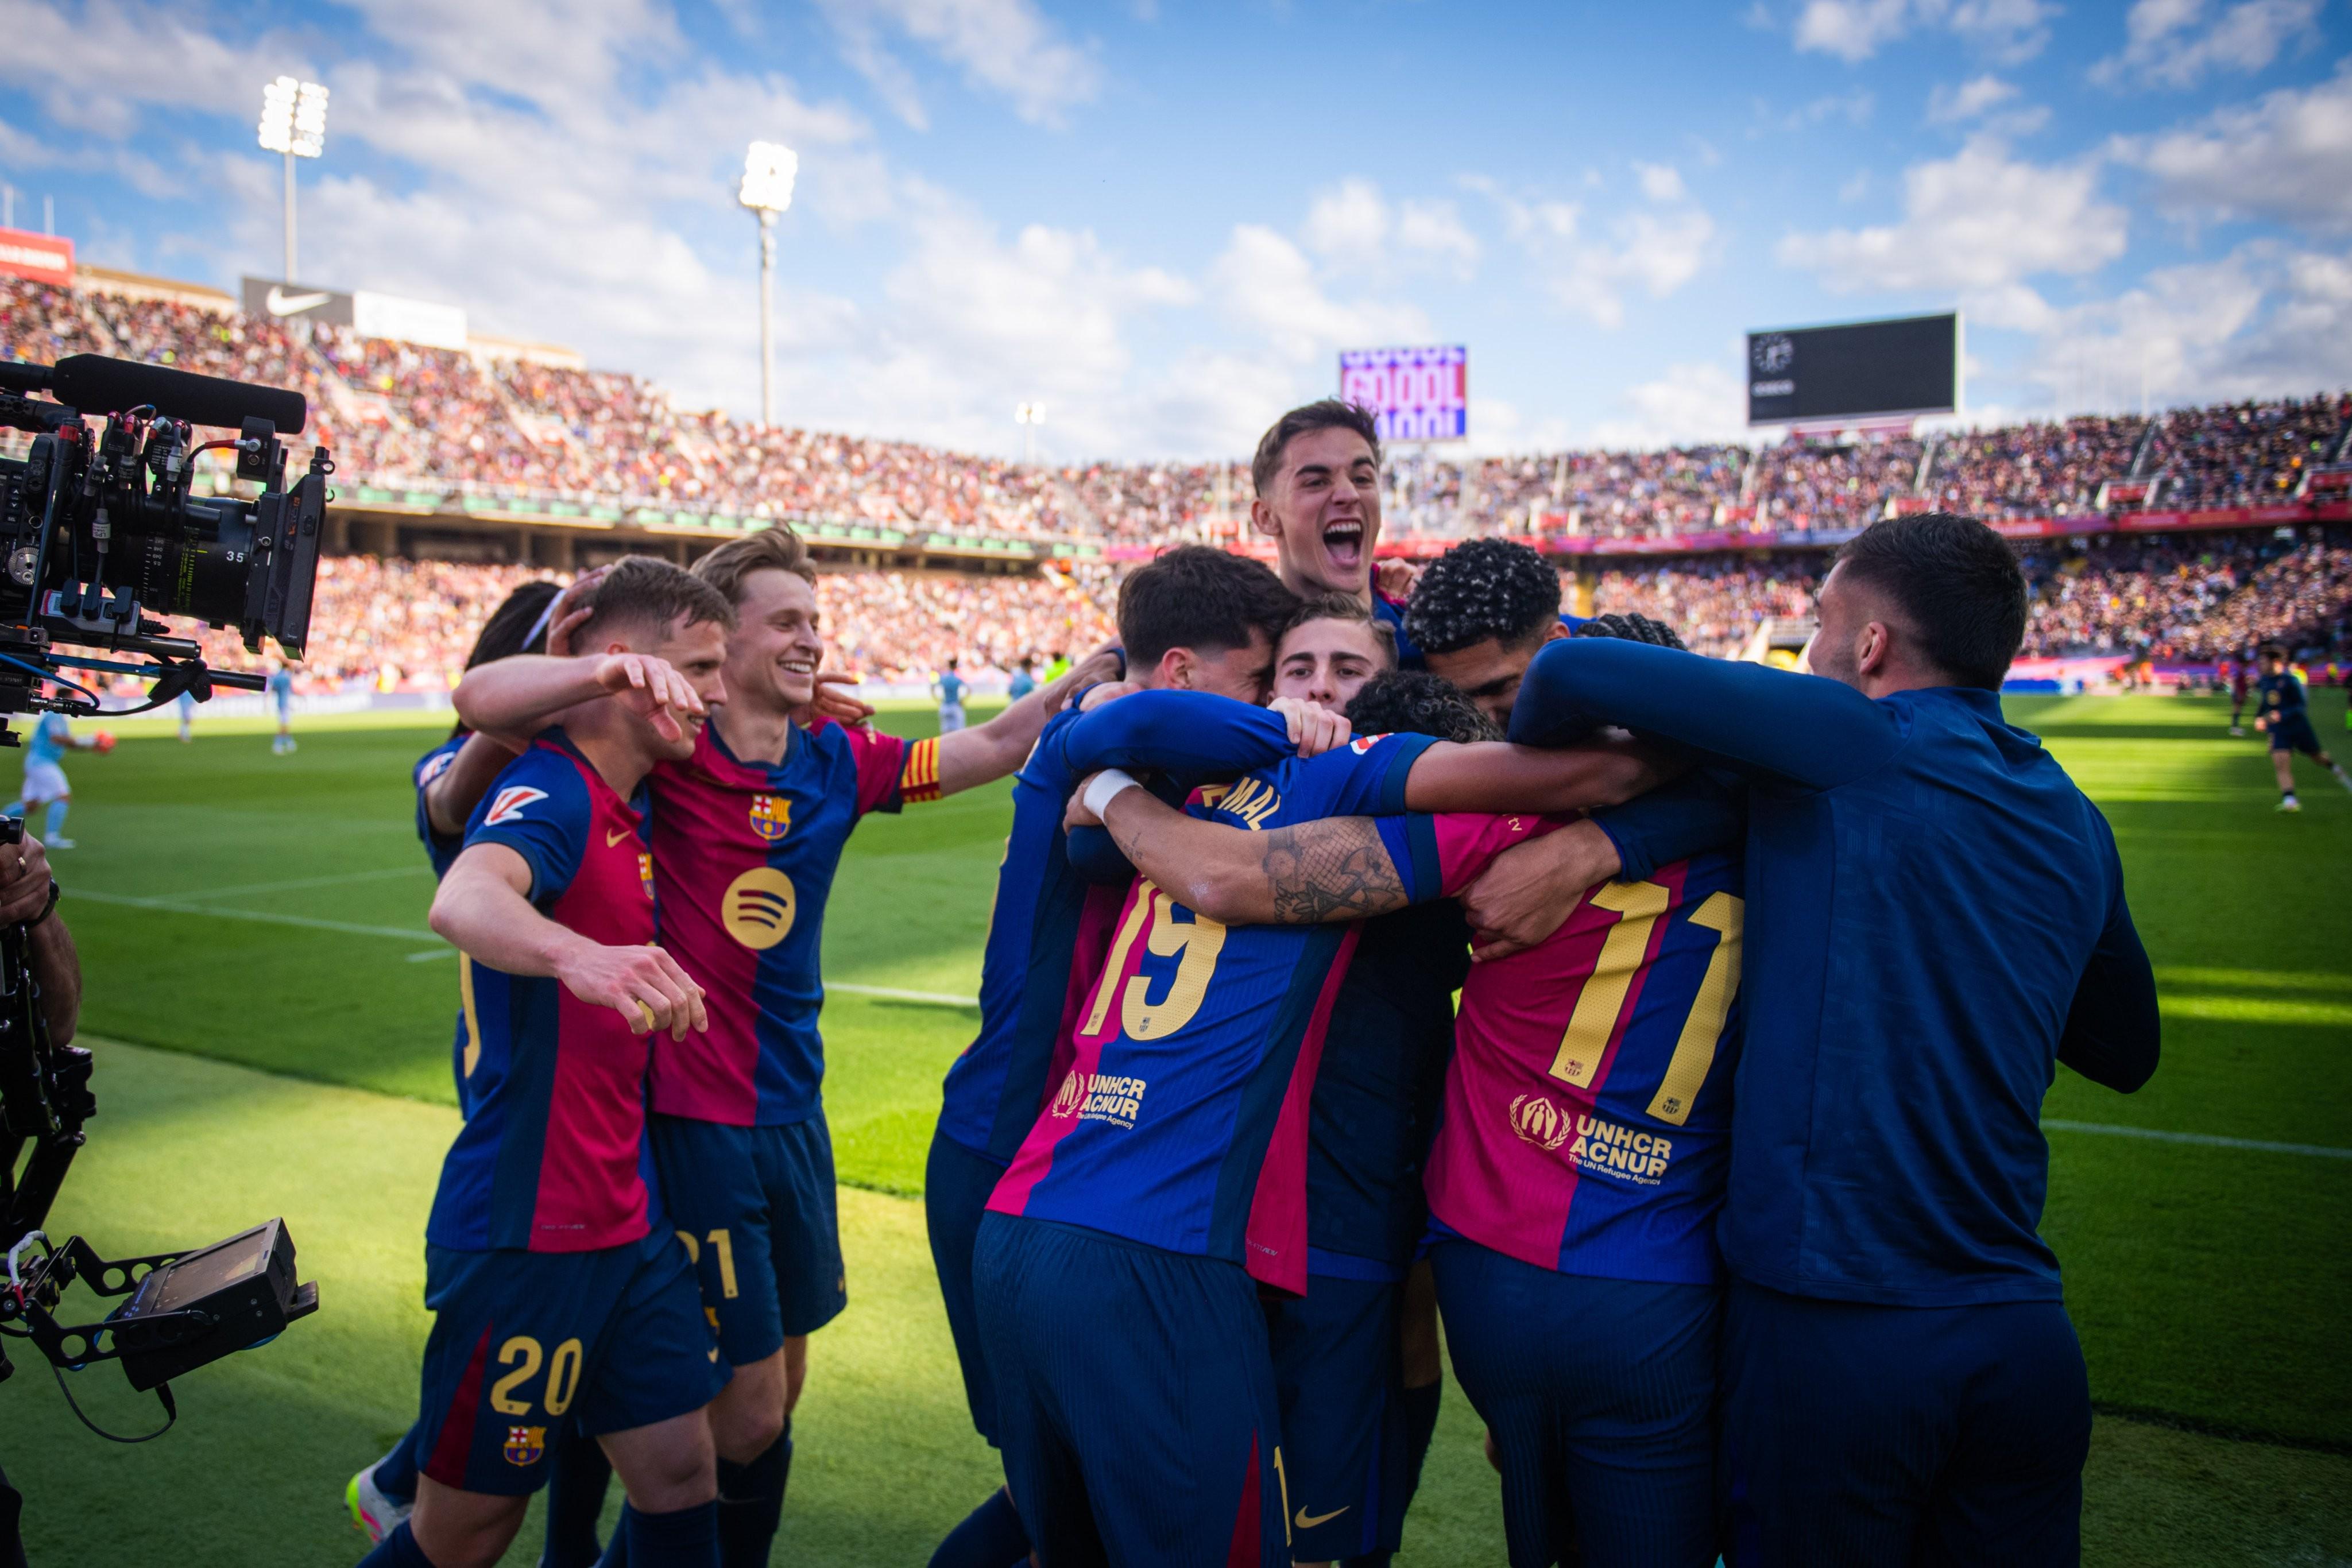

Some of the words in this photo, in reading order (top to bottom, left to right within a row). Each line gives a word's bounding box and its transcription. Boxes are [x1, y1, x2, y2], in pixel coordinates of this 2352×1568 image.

[226, 551, 244, 563] 35
[1080, 875, 1227, 1041] 19
[1548, 880, 1745, 1126] 11
[1088, 1074, 1147, 1100] UNHCR
[1078, 1094, 1140, 1120] ACNUR
[1107, 1116, 1134, 1130] Agency
[1576, 1114, 1672, 1159] UNHCR
[1568, 1153, 1583, 1166] The
[1583, 1160, 1598, 1171] UN
[1597, 1164, 1631, 1180] Refugee
[1633, 1174, 1661, 1186] Agency
[1569, 1136, 1668, 1178] ACNUR
[490, 1335, 582, 1416] 20
